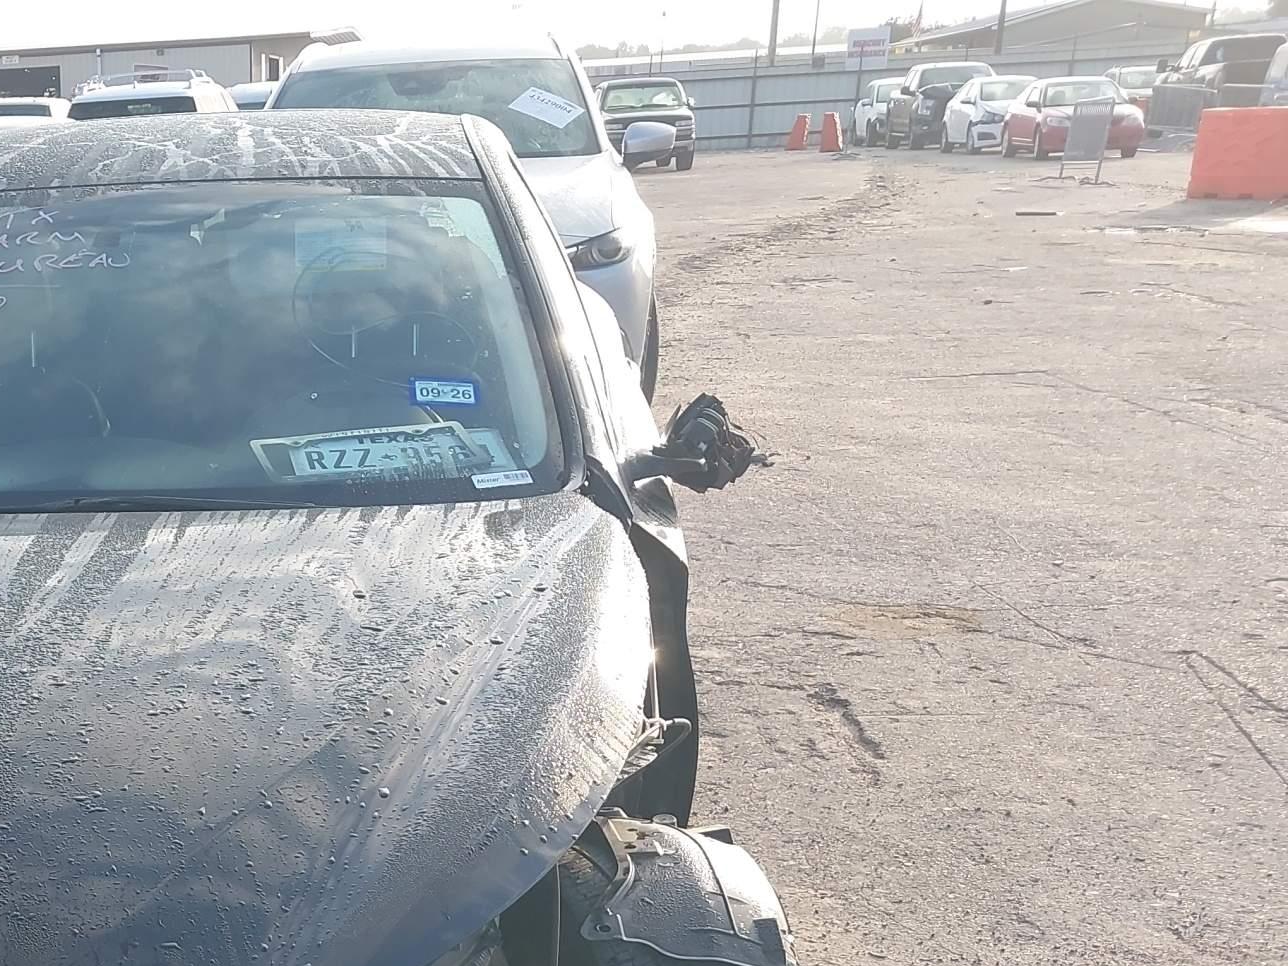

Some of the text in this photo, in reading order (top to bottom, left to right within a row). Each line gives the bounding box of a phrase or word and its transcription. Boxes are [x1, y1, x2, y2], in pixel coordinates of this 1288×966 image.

[420, 387, 472, 400] 09 26
[304, 448, 377, 470] RZZ
